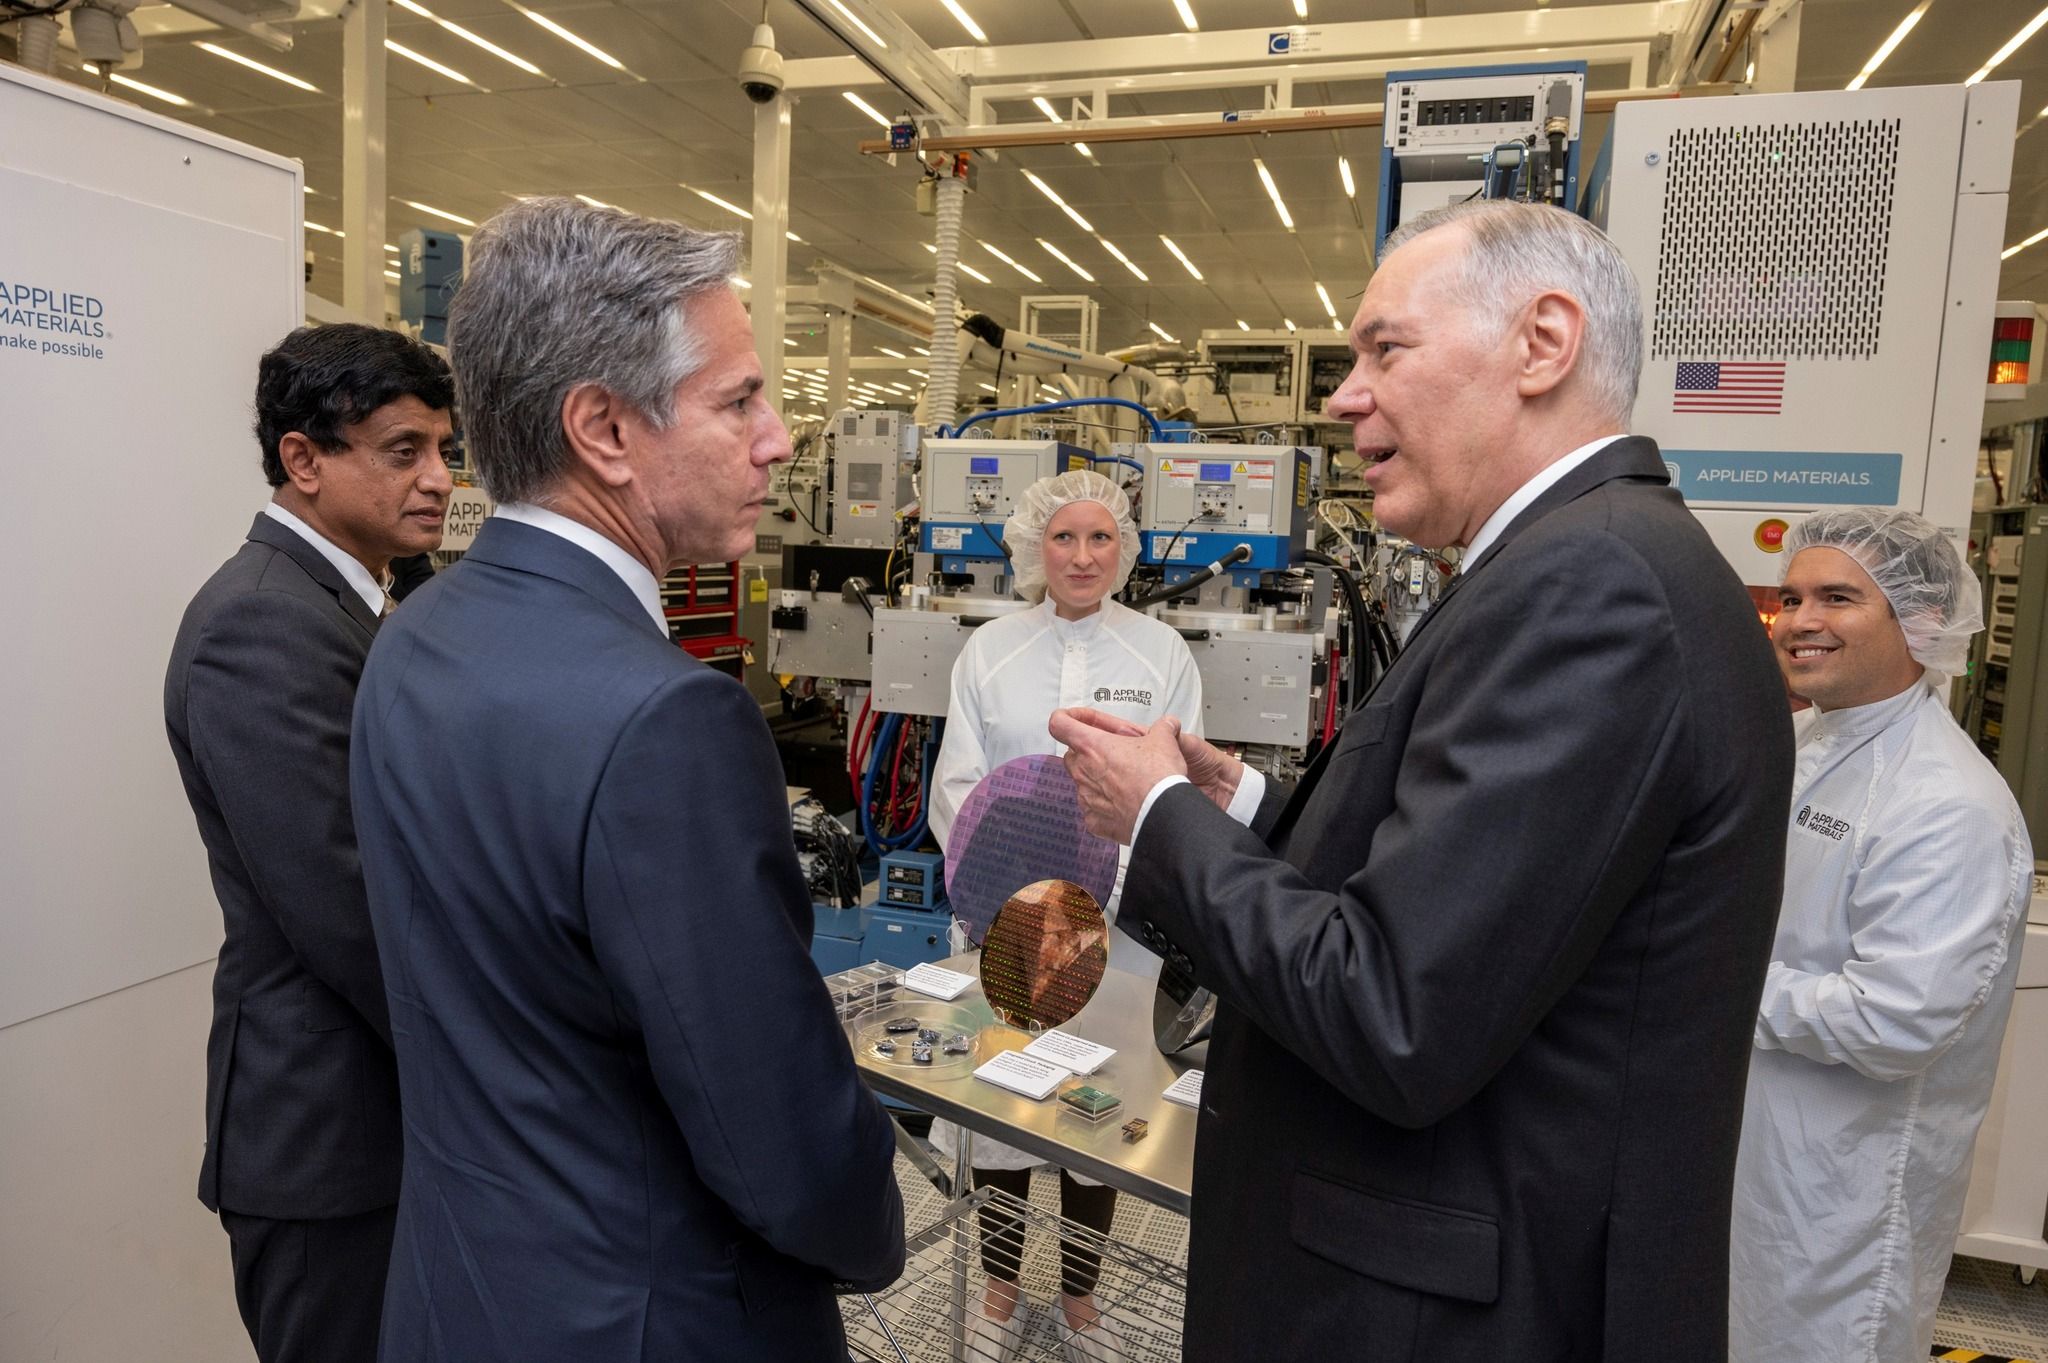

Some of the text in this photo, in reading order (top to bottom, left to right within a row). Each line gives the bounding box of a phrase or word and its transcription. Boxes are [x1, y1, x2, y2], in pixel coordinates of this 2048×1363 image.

[42, 341, 103, 360] possible
[1696, 469, 1870, 485] APPLIED MATERIALS
[449, 502, 497, 520] APPLI
[1113, 689, 1152, 699] APPLIED
[1113, 696, 1151, 706] MATERIALS
[1808, 822, 1844, 841] MATERIALS
[1811, 812, 1850, 833] APPLIED
